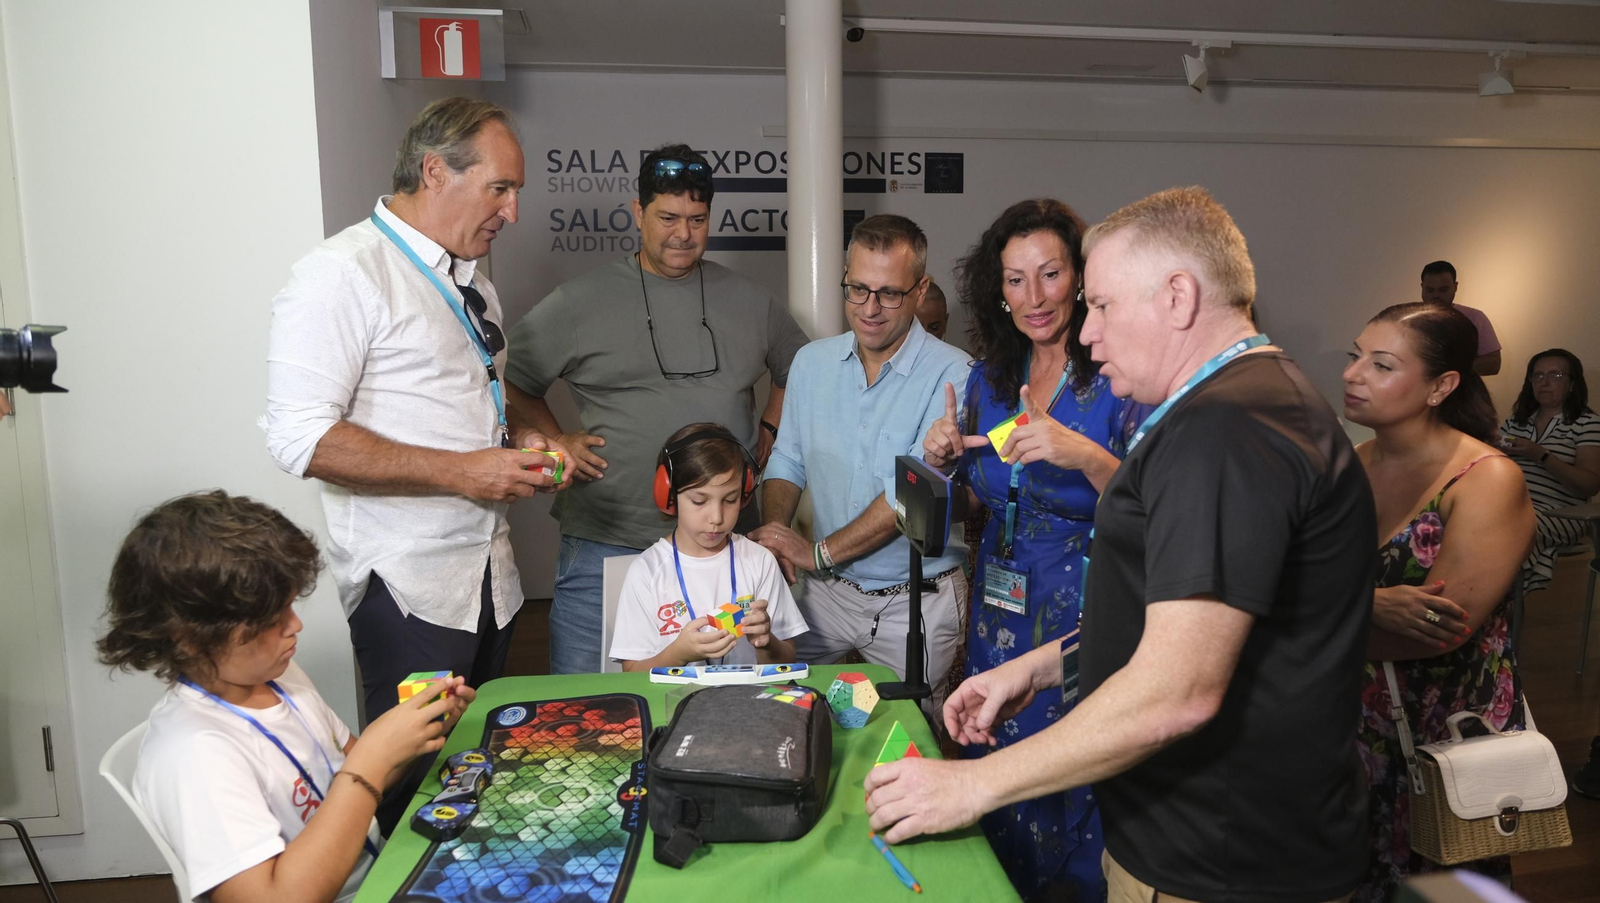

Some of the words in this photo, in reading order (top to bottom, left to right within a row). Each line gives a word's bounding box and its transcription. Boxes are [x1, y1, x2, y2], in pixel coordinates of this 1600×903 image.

[547, 149, 629, 174] SALA
[547, 176, 640, 193] SHOWR
[549, 203, 642, 233] SALÓ
[718, 208, 788, 233] ACT
[550, 235, 644, 252] AUDITO
